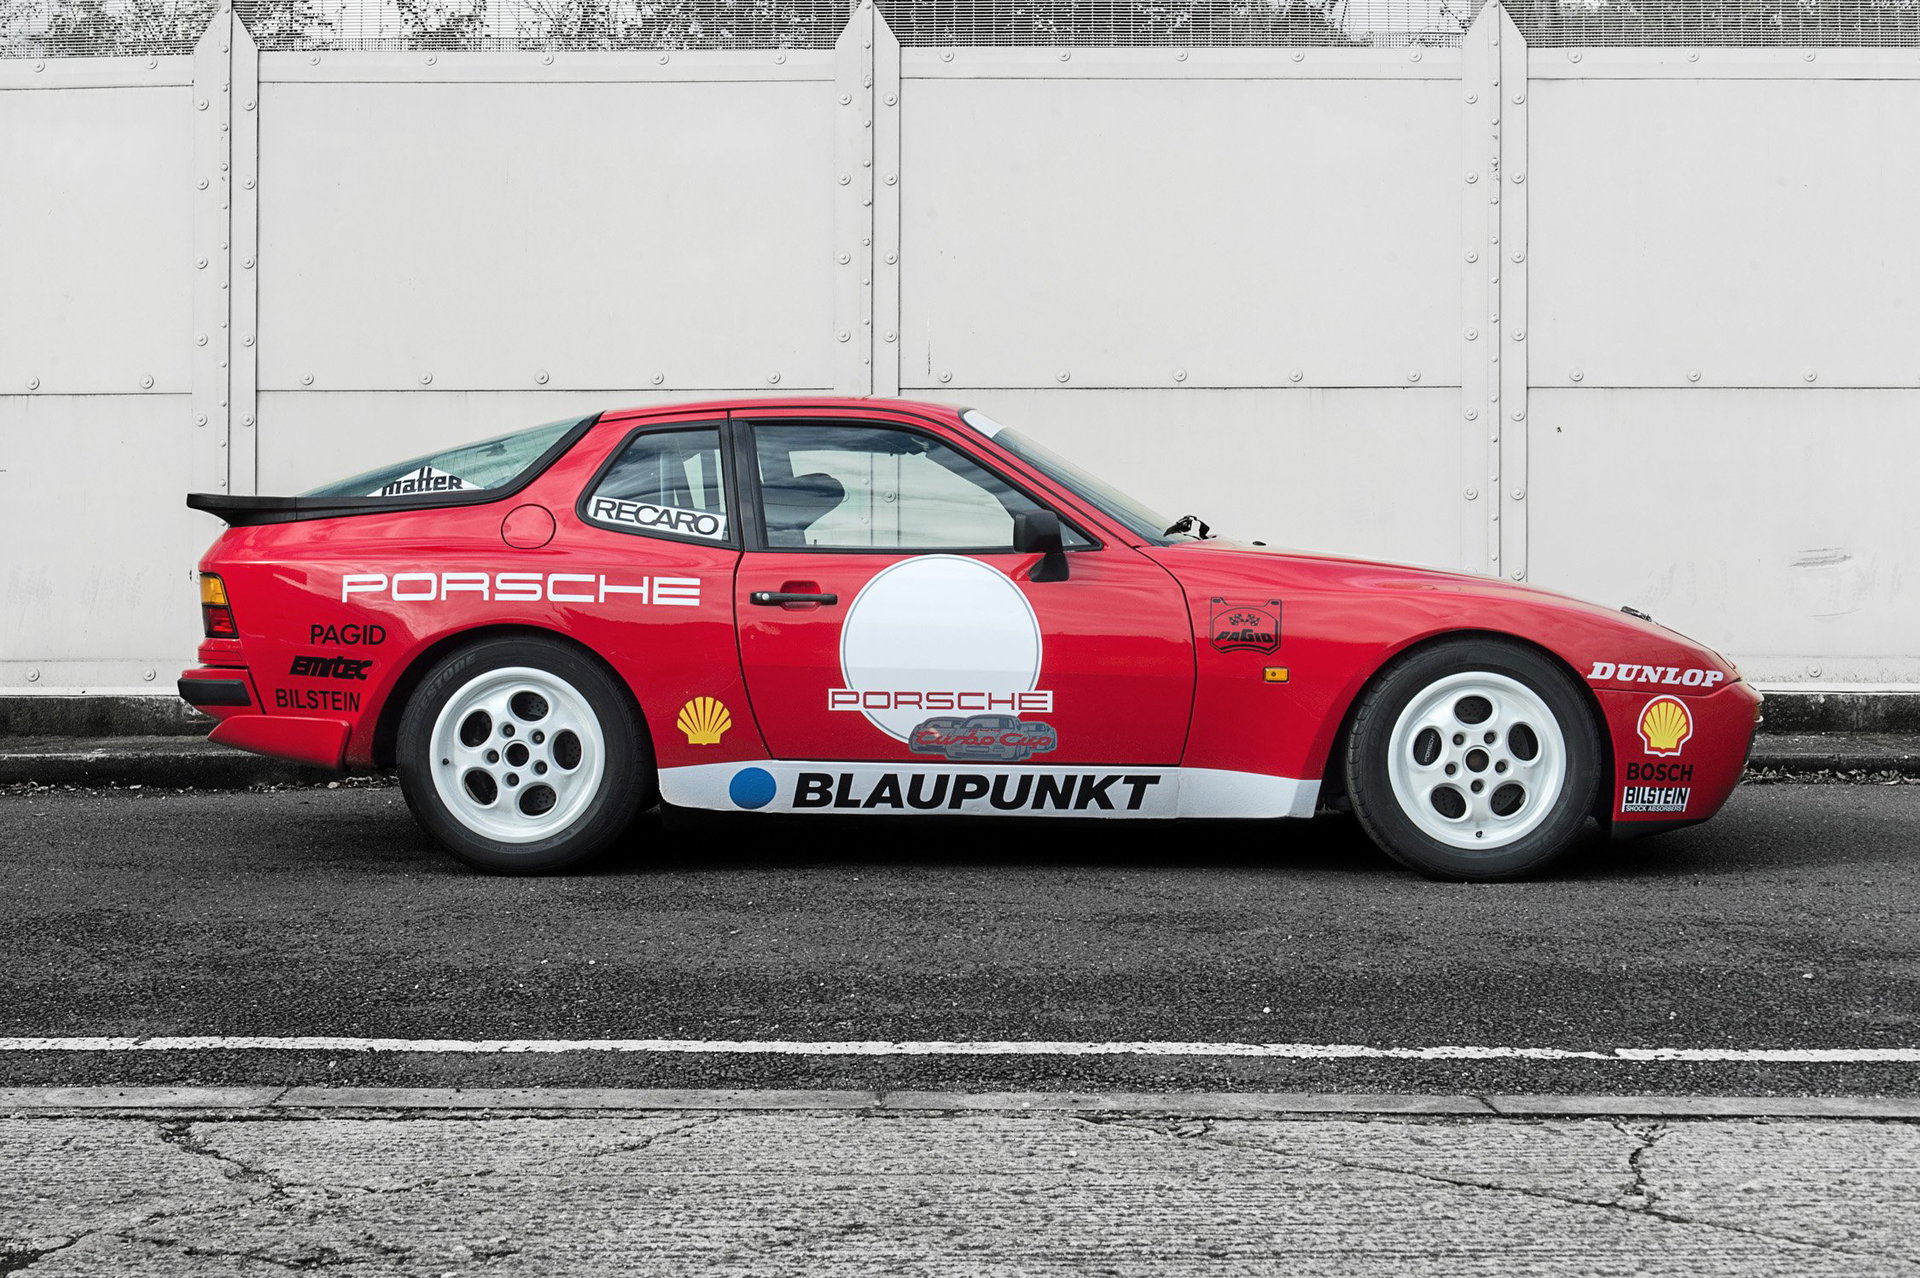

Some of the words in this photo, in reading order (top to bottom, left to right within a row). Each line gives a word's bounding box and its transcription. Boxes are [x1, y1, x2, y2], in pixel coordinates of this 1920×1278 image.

[592, 499, 719, 537] RECARO
[341, 572, 701, 607] PORSCHE
[310, 623, 387, 646] PAGID
[1586, 661, 1725, 688] DUNLOP
[275, 688, 361, 713] BILSTEIN
[830, 690, 1049, 711] PORSCHE
[915, 728, 996, 746] Turbo
[999, 731, 1053, 750] Cup
[1626, 763, 1694, 782] BOSCH
[791, 772, 1162, 811] BLAUPUNKT
[1625, 788, 1688, 804] BILSTEIN
